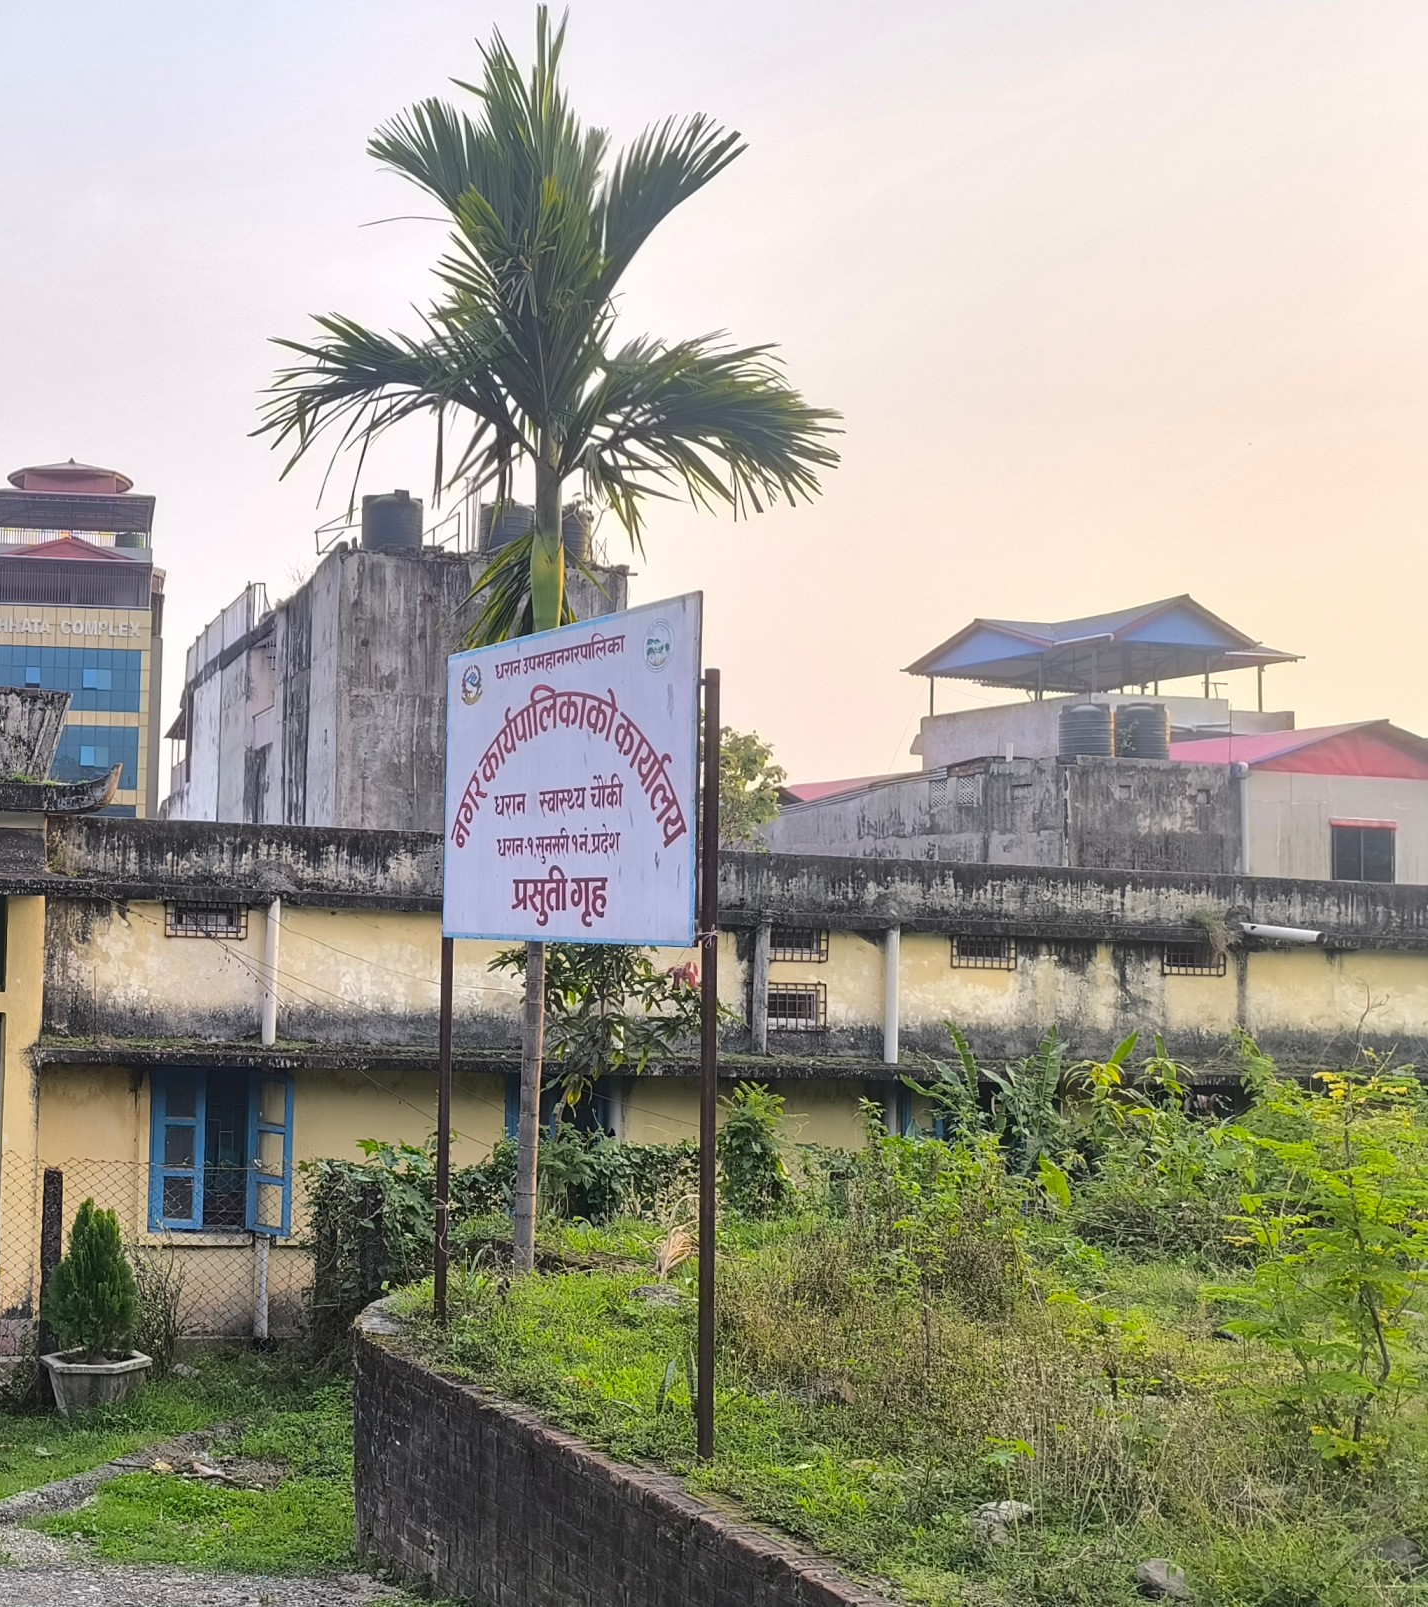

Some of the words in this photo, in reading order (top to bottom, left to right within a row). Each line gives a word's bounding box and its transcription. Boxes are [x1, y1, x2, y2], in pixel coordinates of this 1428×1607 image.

[60, 619, 141, 638] COMPLEX
[495, 659, 522, 680] धरान
[522, 633, 625, 674] उपमहानगरपालिका
[451, 770, 487, 848] नगर
[478, 684, 618, 783] कार्यपालिकाको
[614, 711, 687, 848] कार्यालय
[494, 793, 526, 820] धरान
[539, 787, 586, 817] स्वास्थ्य
[512, 865, 568, 926] प्रसुती
[571, 877, 608, 927] गृह
